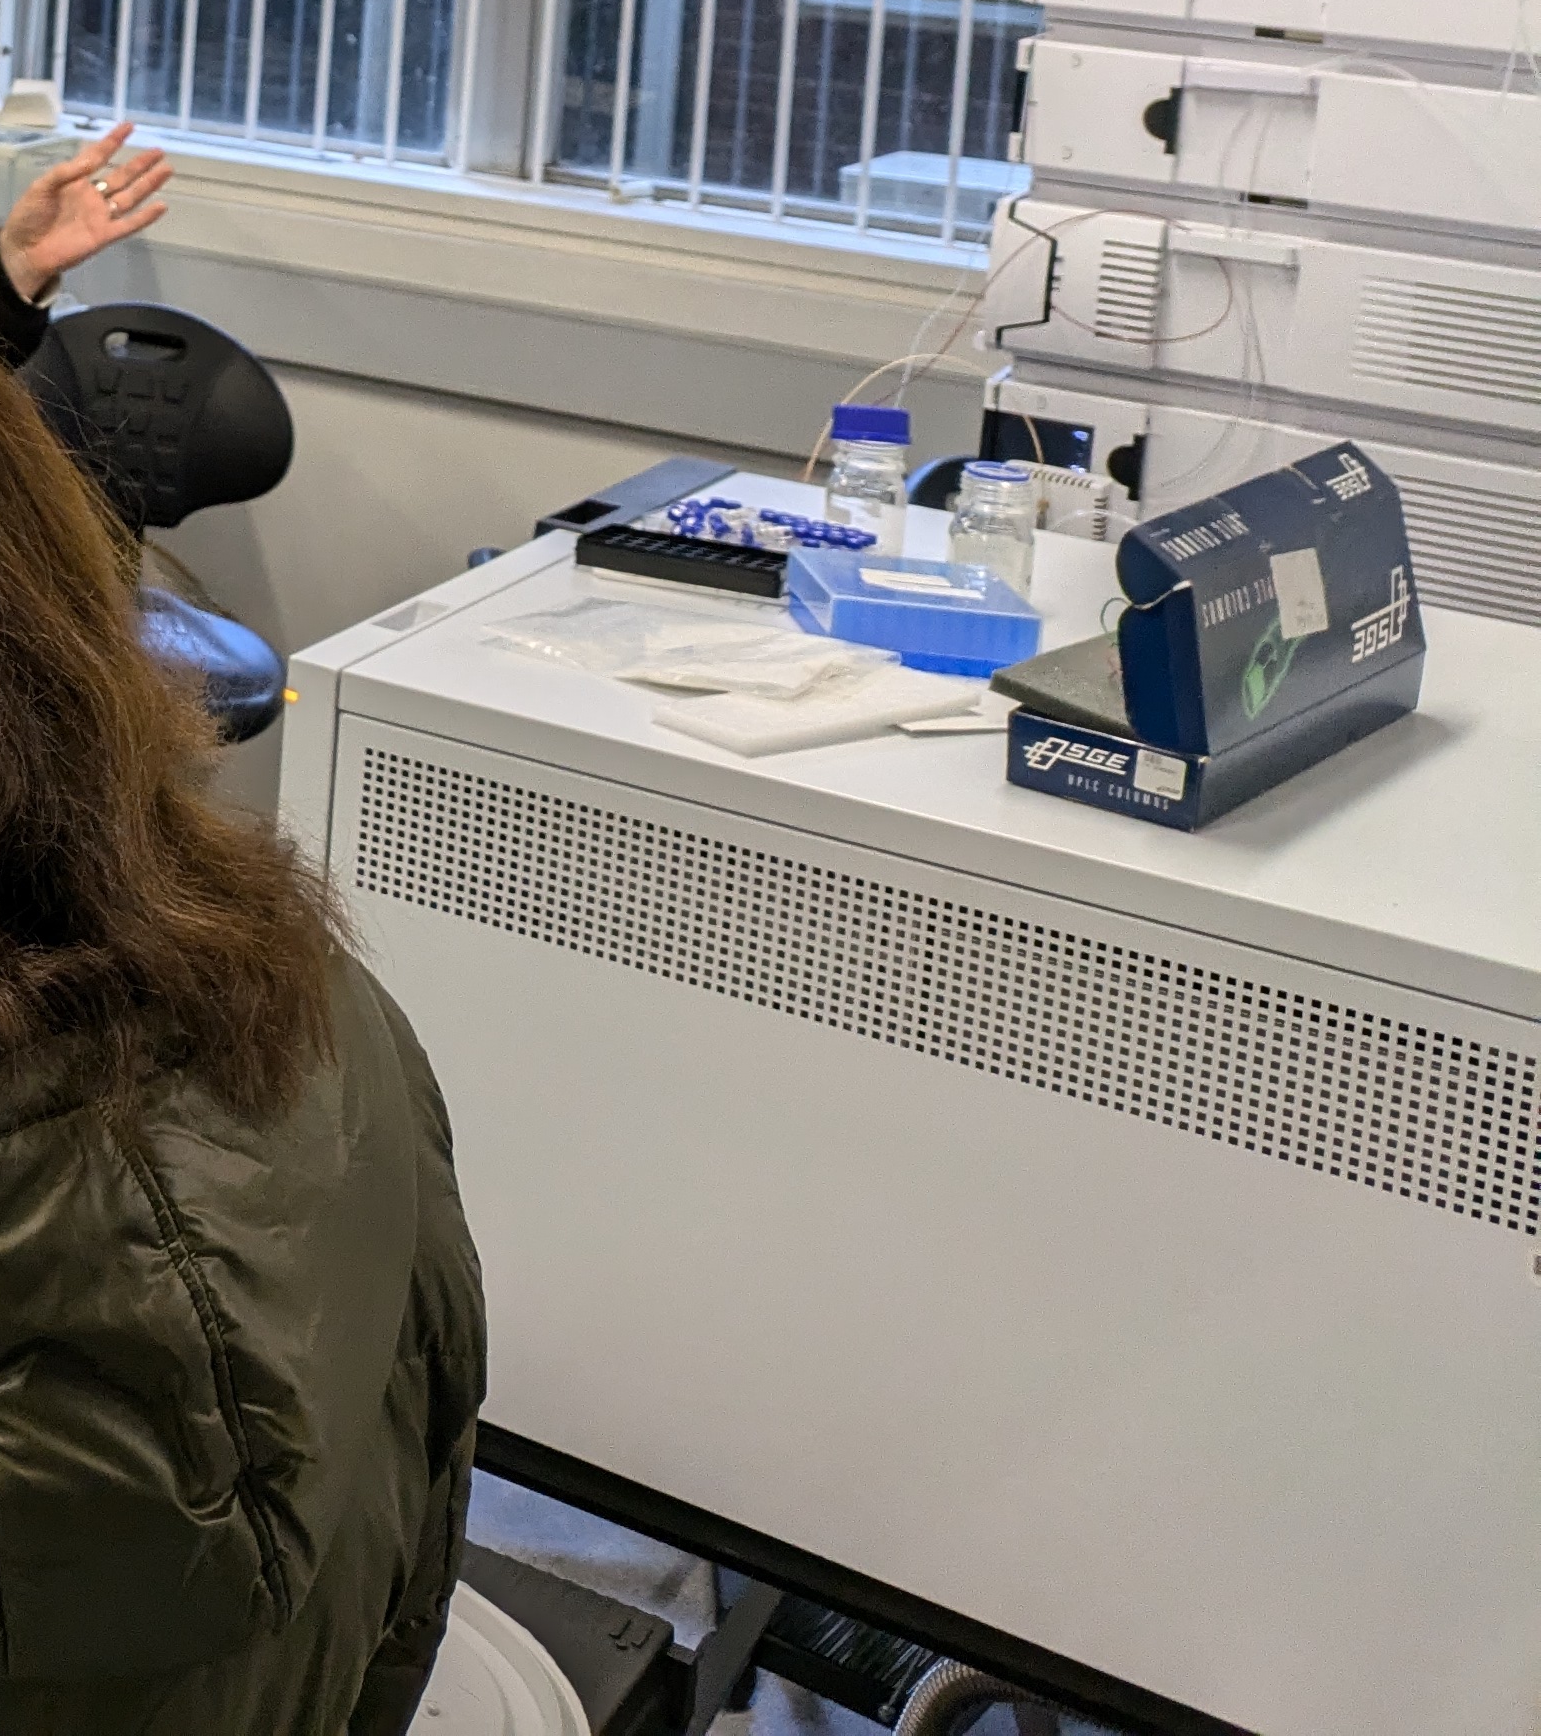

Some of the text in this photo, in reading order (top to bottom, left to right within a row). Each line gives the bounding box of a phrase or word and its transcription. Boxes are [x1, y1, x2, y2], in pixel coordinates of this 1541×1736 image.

[1066, 744, 1130, 769] SGE
[1068, 773, 1170, 812] HPLC COLUMNS
